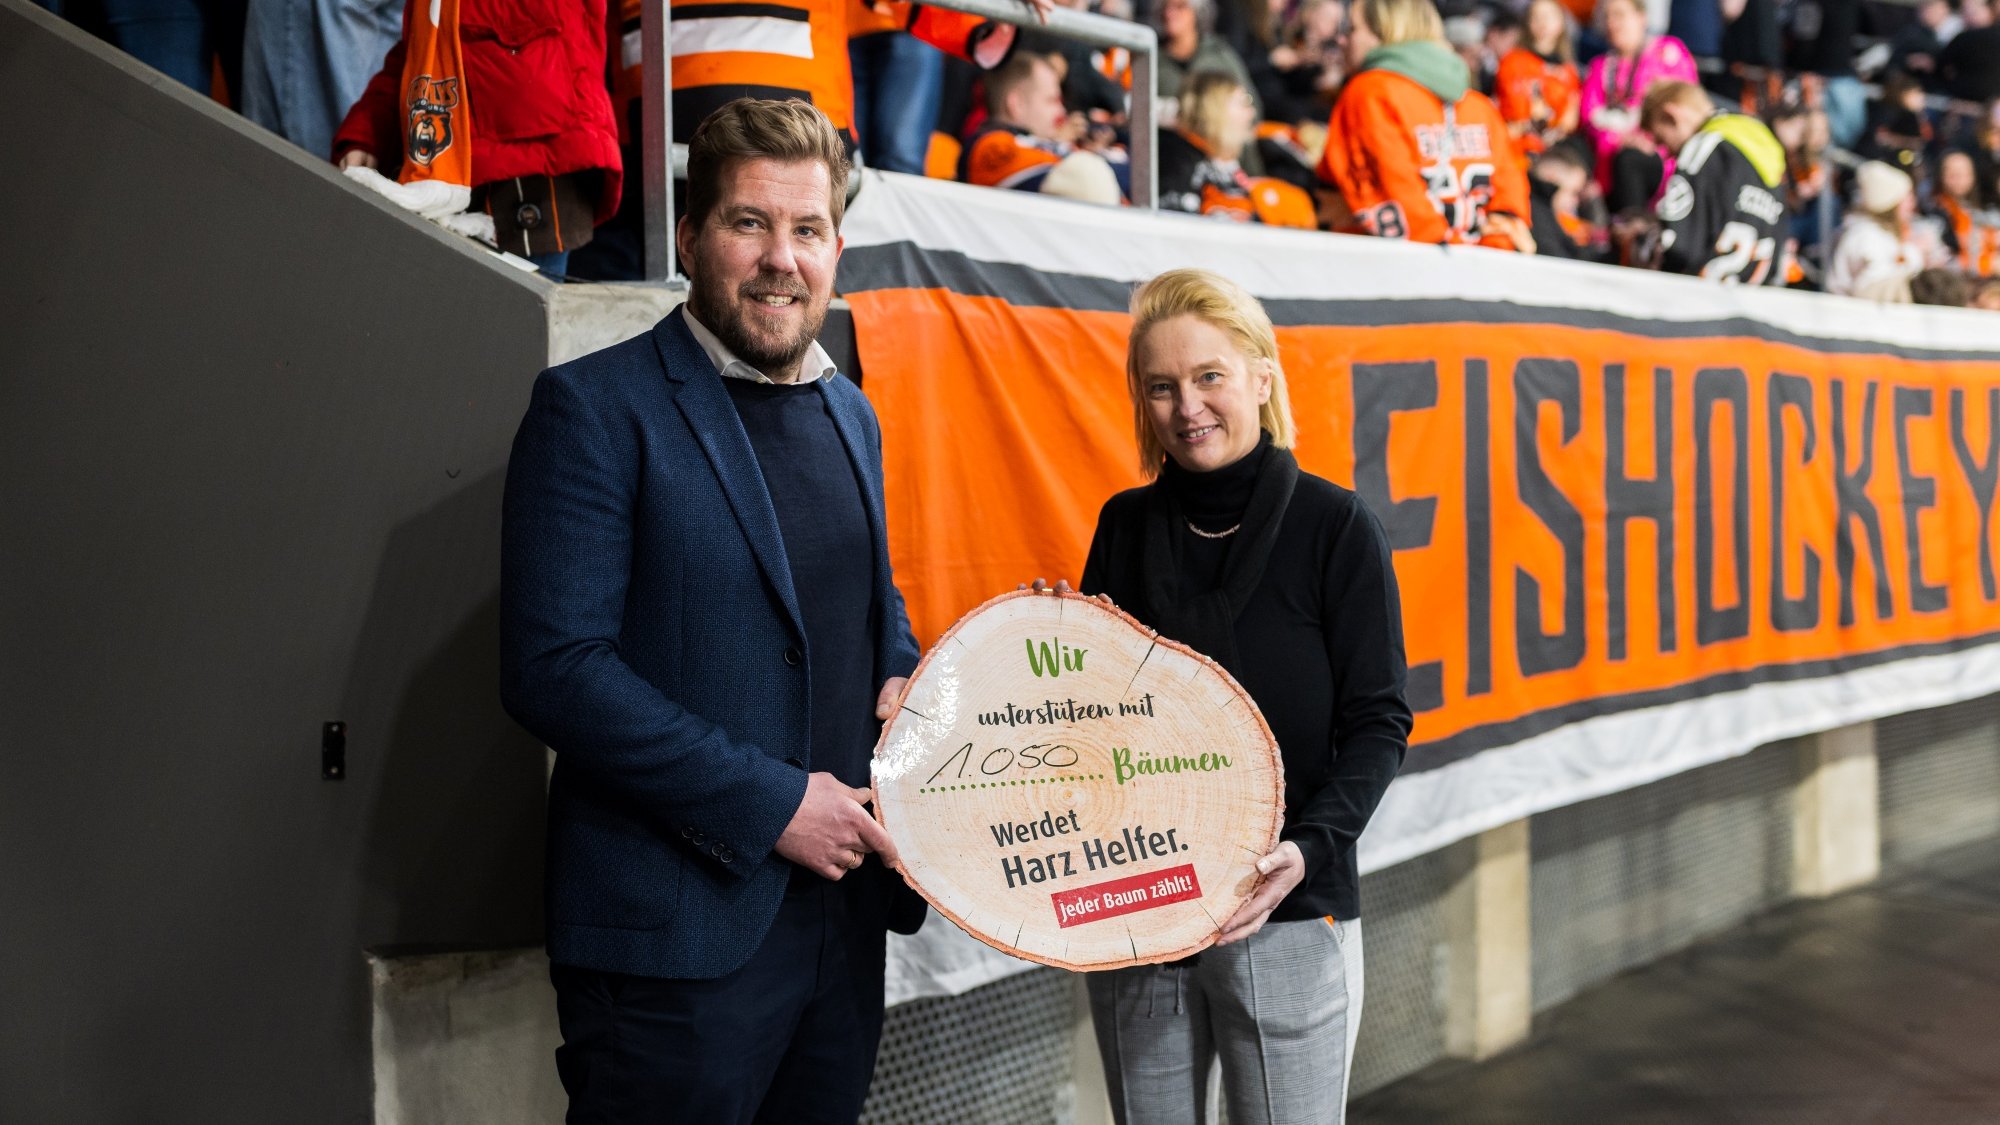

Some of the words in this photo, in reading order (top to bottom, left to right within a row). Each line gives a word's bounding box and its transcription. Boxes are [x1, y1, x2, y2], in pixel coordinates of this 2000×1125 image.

[1352, 358, 2000, 713] EISHOCKEY
[1025, 636, 1088, 678] Wir
[977, 699, 1112, 727] unterstützen
[1119, 693, 1154, 718] mit
[927, 742, 1079, 785] 1.050
[1112, 746, 1233, 785] Bäumen
[990, 808, 1082, 847] Werdet
[1002, 851, 1077, 889] Harz
[1083, 825, 1189, 872] Helfer.
[1103, 888, 1147, 909] Baum
[1150, 875, 1193, 899] zählt!
